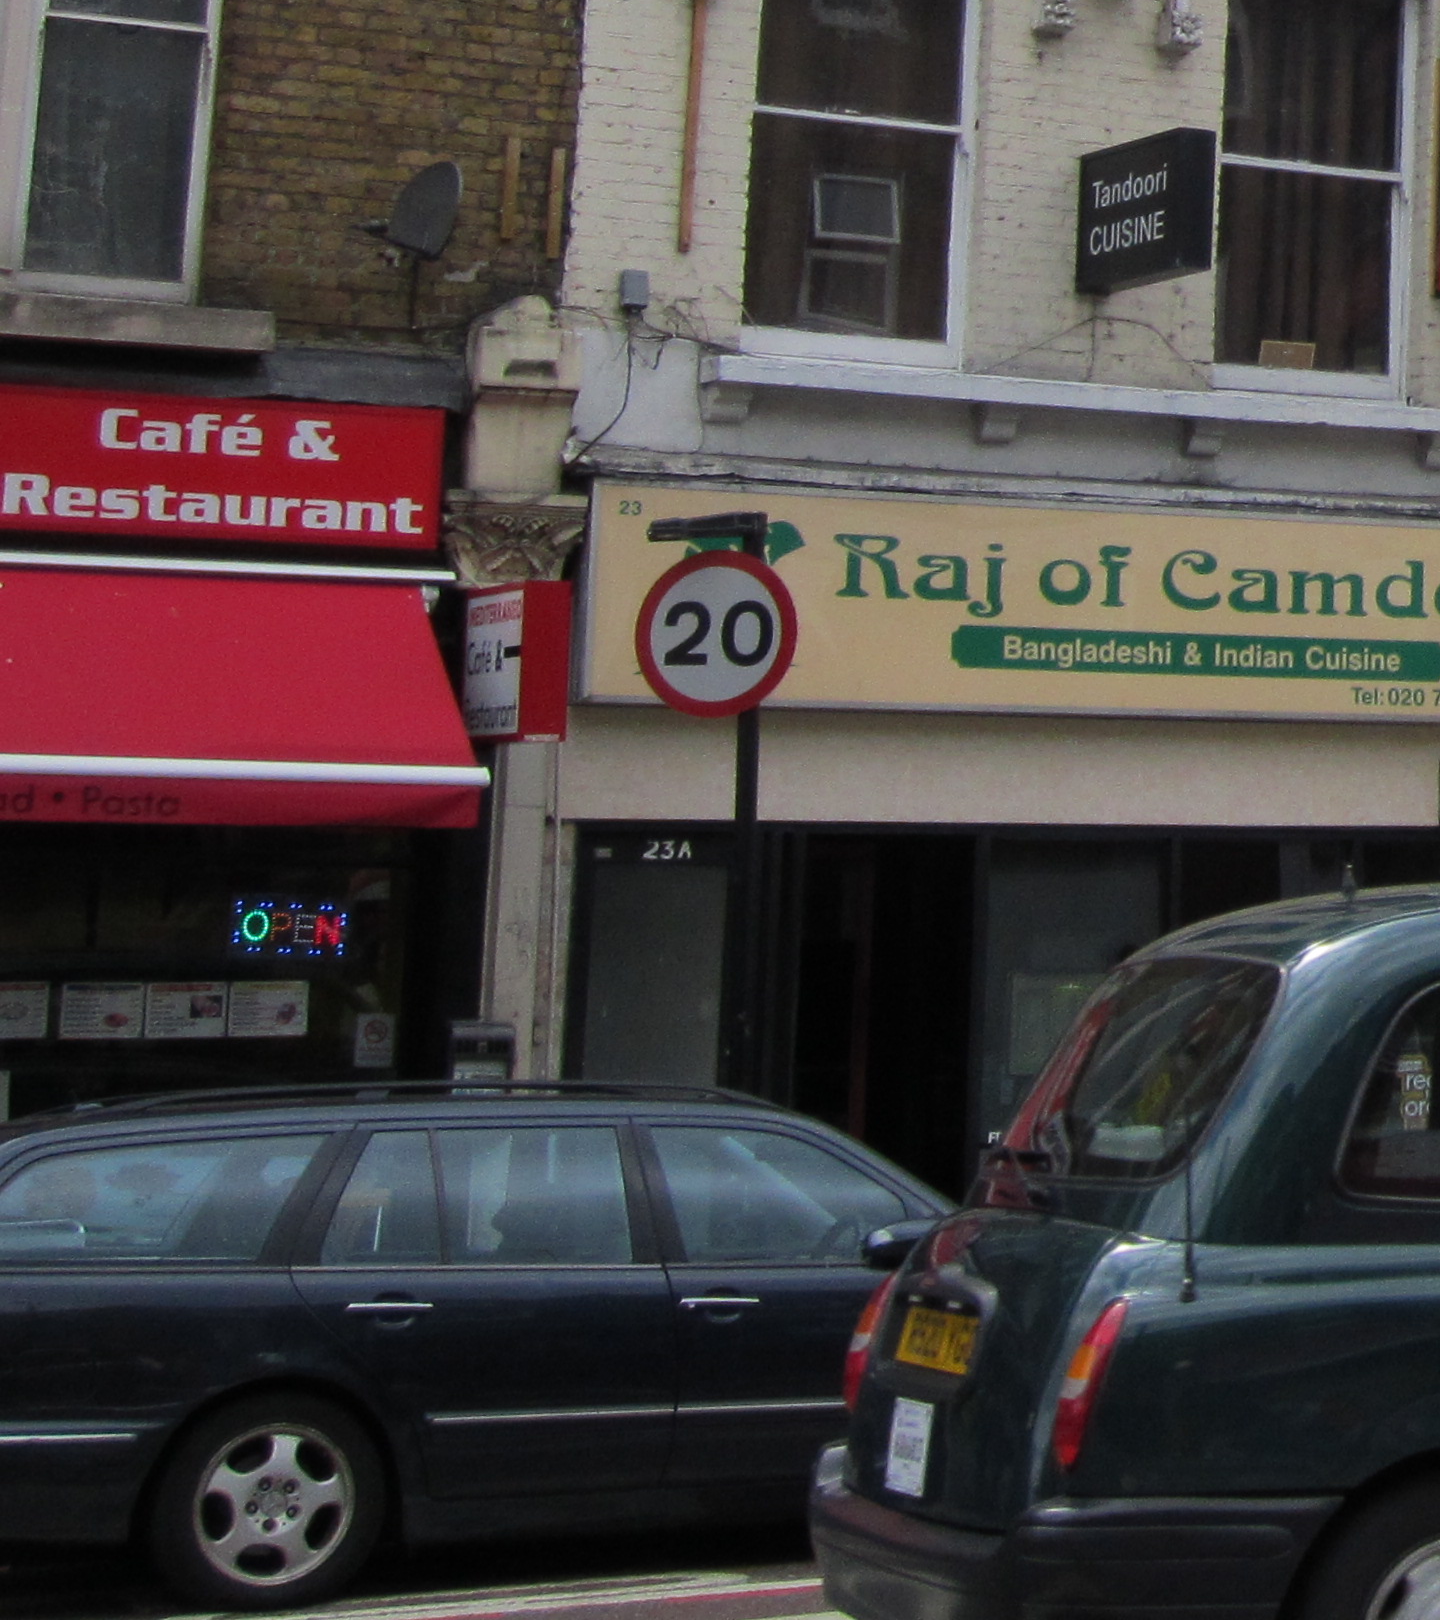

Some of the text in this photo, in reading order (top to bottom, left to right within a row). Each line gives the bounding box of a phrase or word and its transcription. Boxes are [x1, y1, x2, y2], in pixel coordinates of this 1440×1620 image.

[1092, 163, 1168, 209] Tandoori
[1089, 210, 1166, 256] CUISINE
[99, 407, 341, 462] Café &
[0, 471, 424, 535] Restaurant
[619, 500, 642, 516] 23
[833, 532, 1007, 619] Raj
[1037, 544, 1133, 608] of
[663, 599, 774, 667] 20
[1002, 634, 1402, 673] Bangladeshi & Indian Cuisine
[81, 785, 181, 817] Pasta
[242, 909, 342, 946] OPEN
